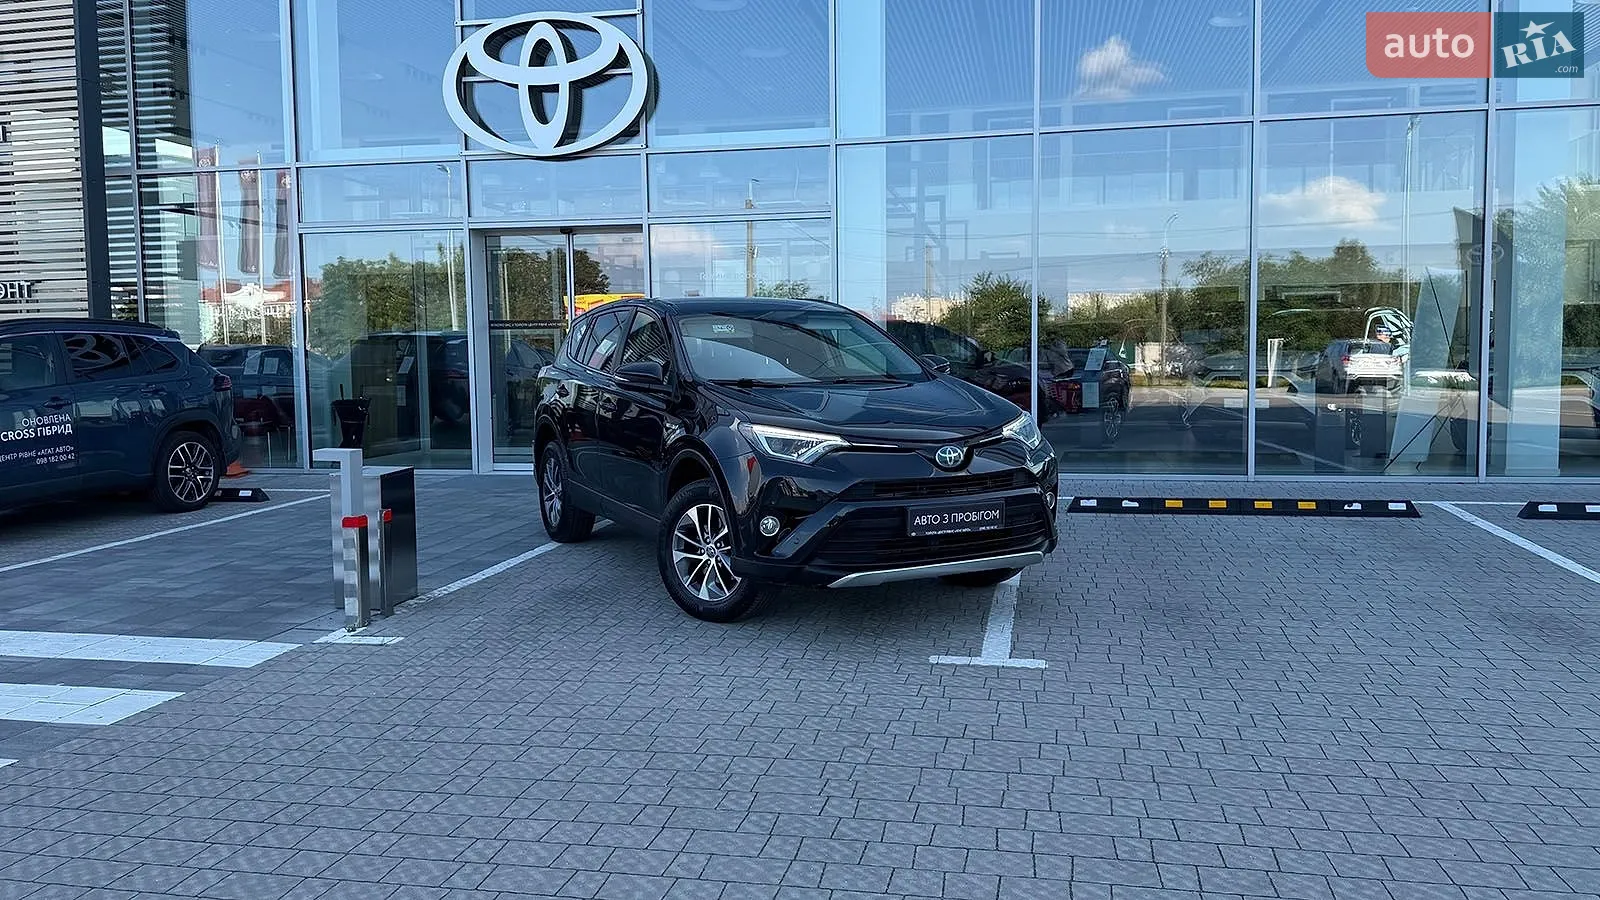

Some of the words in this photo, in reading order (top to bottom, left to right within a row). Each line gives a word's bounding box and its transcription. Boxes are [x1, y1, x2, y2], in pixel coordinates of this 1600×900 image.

[21, 413, 72, 427] ОНОВЛЕНА
[0, 428, 36, 442] CROSS
[37, 423, 73, 437] ГІБРИД
[913, 514, 941, 526] АВТО
[951, 509, 1000, 523] ПРОБІГОМ
